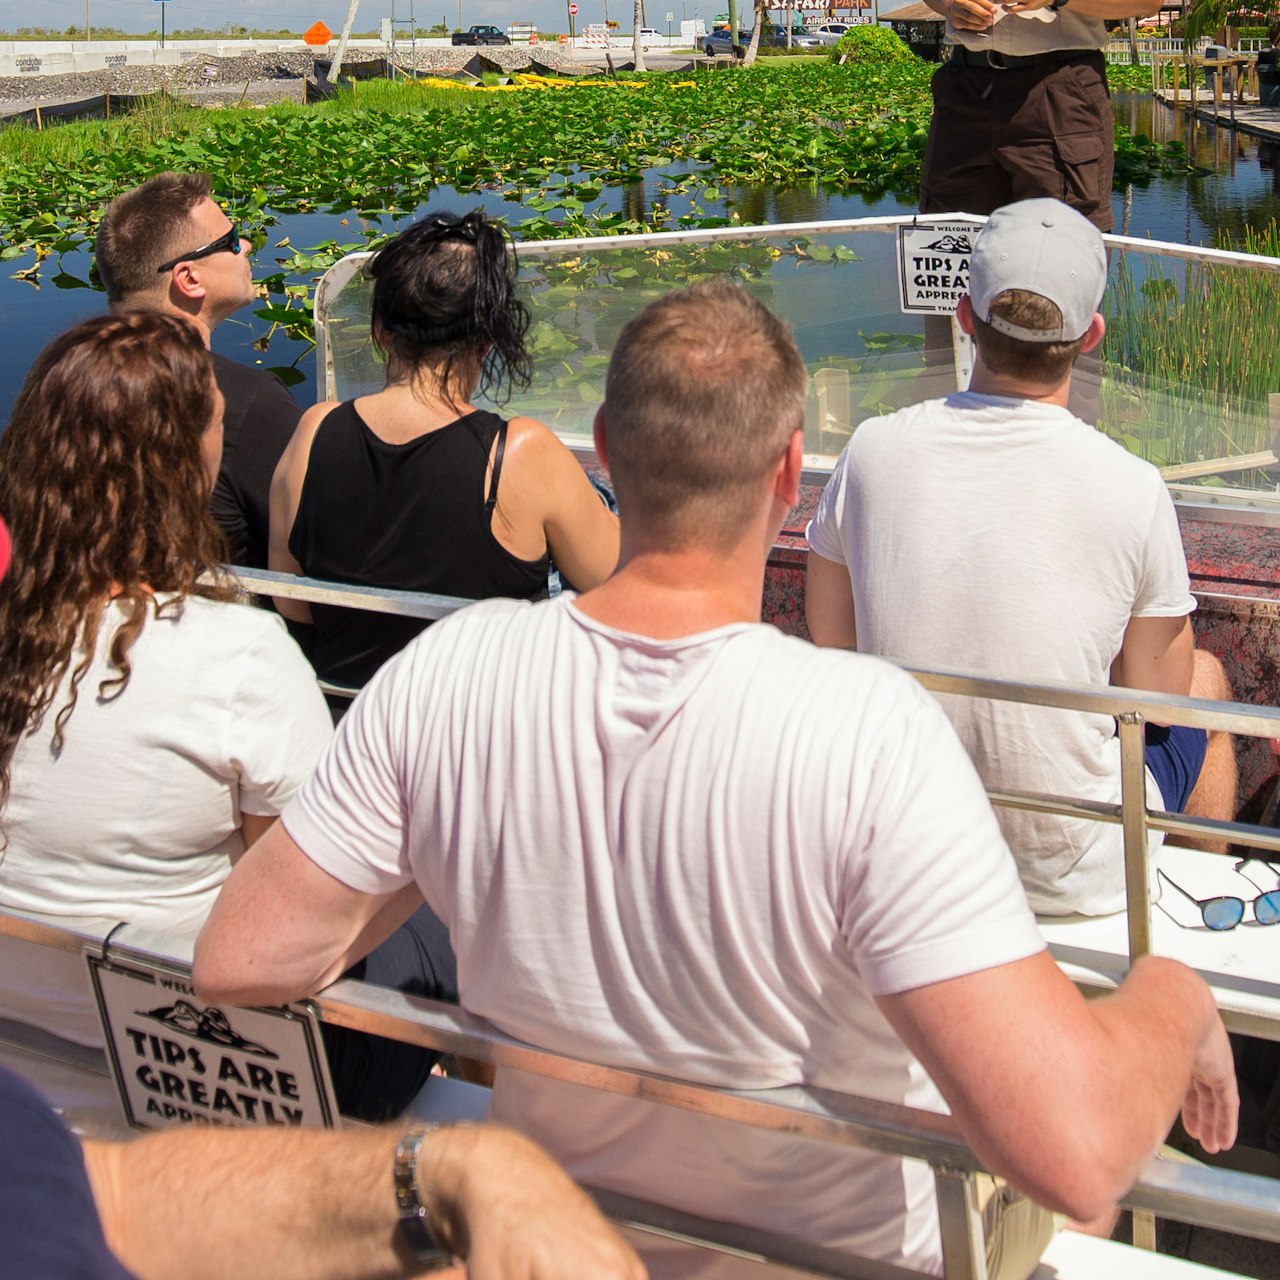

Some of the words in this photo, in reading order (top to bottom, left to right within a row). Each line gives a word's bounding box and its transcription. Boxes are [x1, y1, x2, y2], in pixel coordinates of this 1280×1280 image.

[805, 16, 842, 25] AIRBOAT
[844, 16, 870, 24] RIDES
[912, 257, 952, 271] TIPS
[913, 274, 970, 288] GREA
[125, 1026, 207, 1075] TIPS
[218, 1056, 301, 1102] ARE
[135, 1065, 304, 1126] GREATLY
